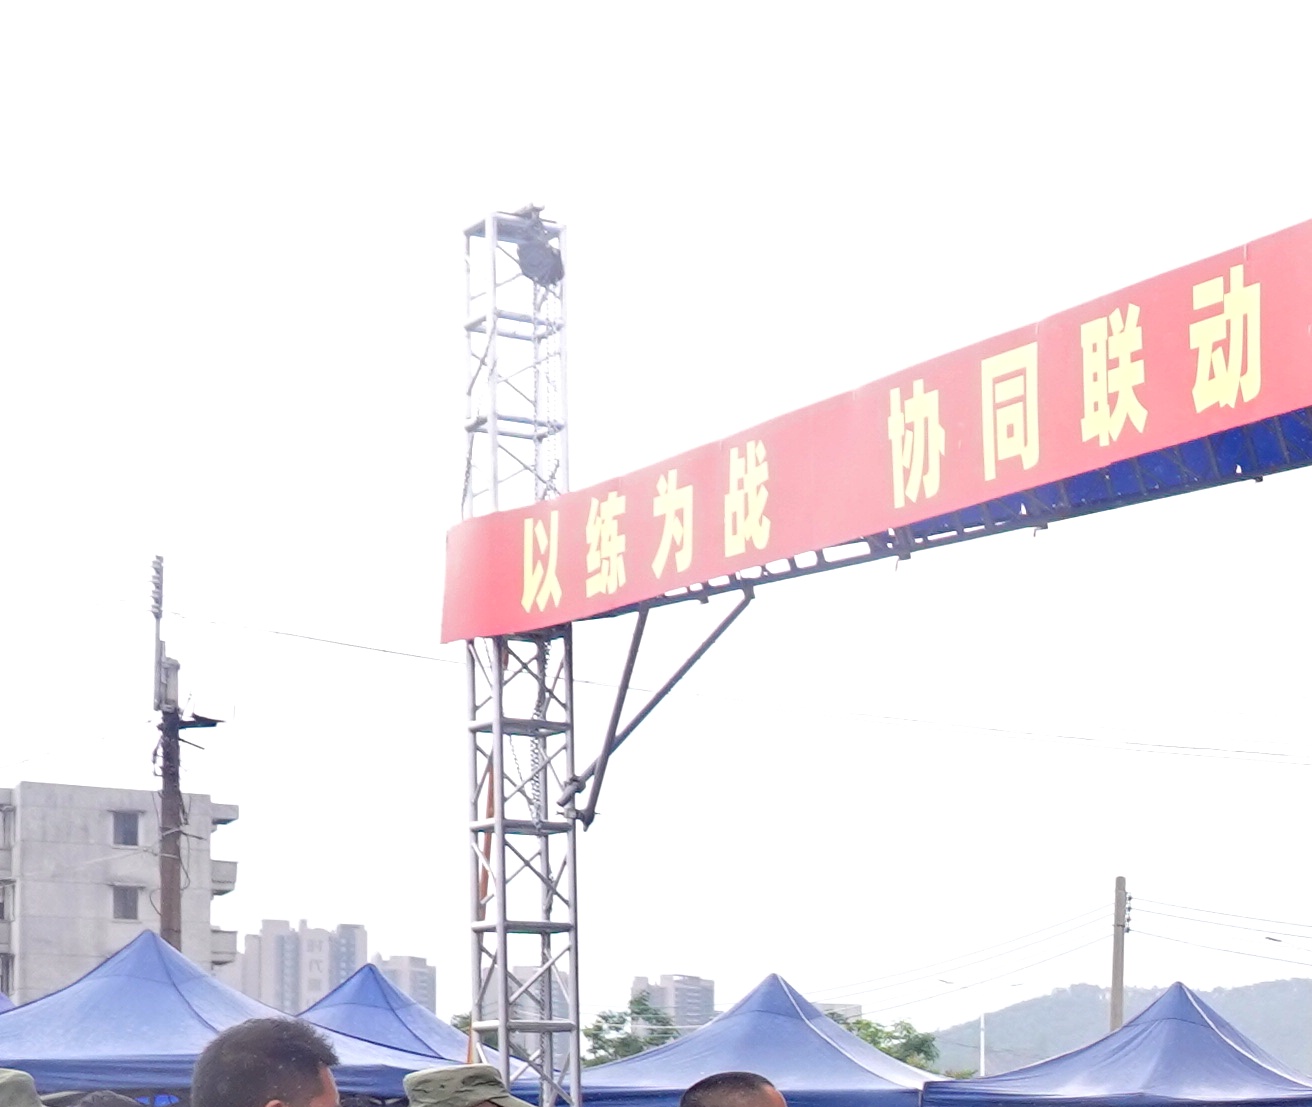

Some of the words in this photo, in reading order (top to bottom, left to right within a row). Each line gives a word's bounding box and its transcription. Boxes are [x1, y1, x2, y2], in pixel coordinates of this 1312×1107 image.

[521, 438, 771, 613] 以练为战
[888, 264, 1263, 509] 协同联动
